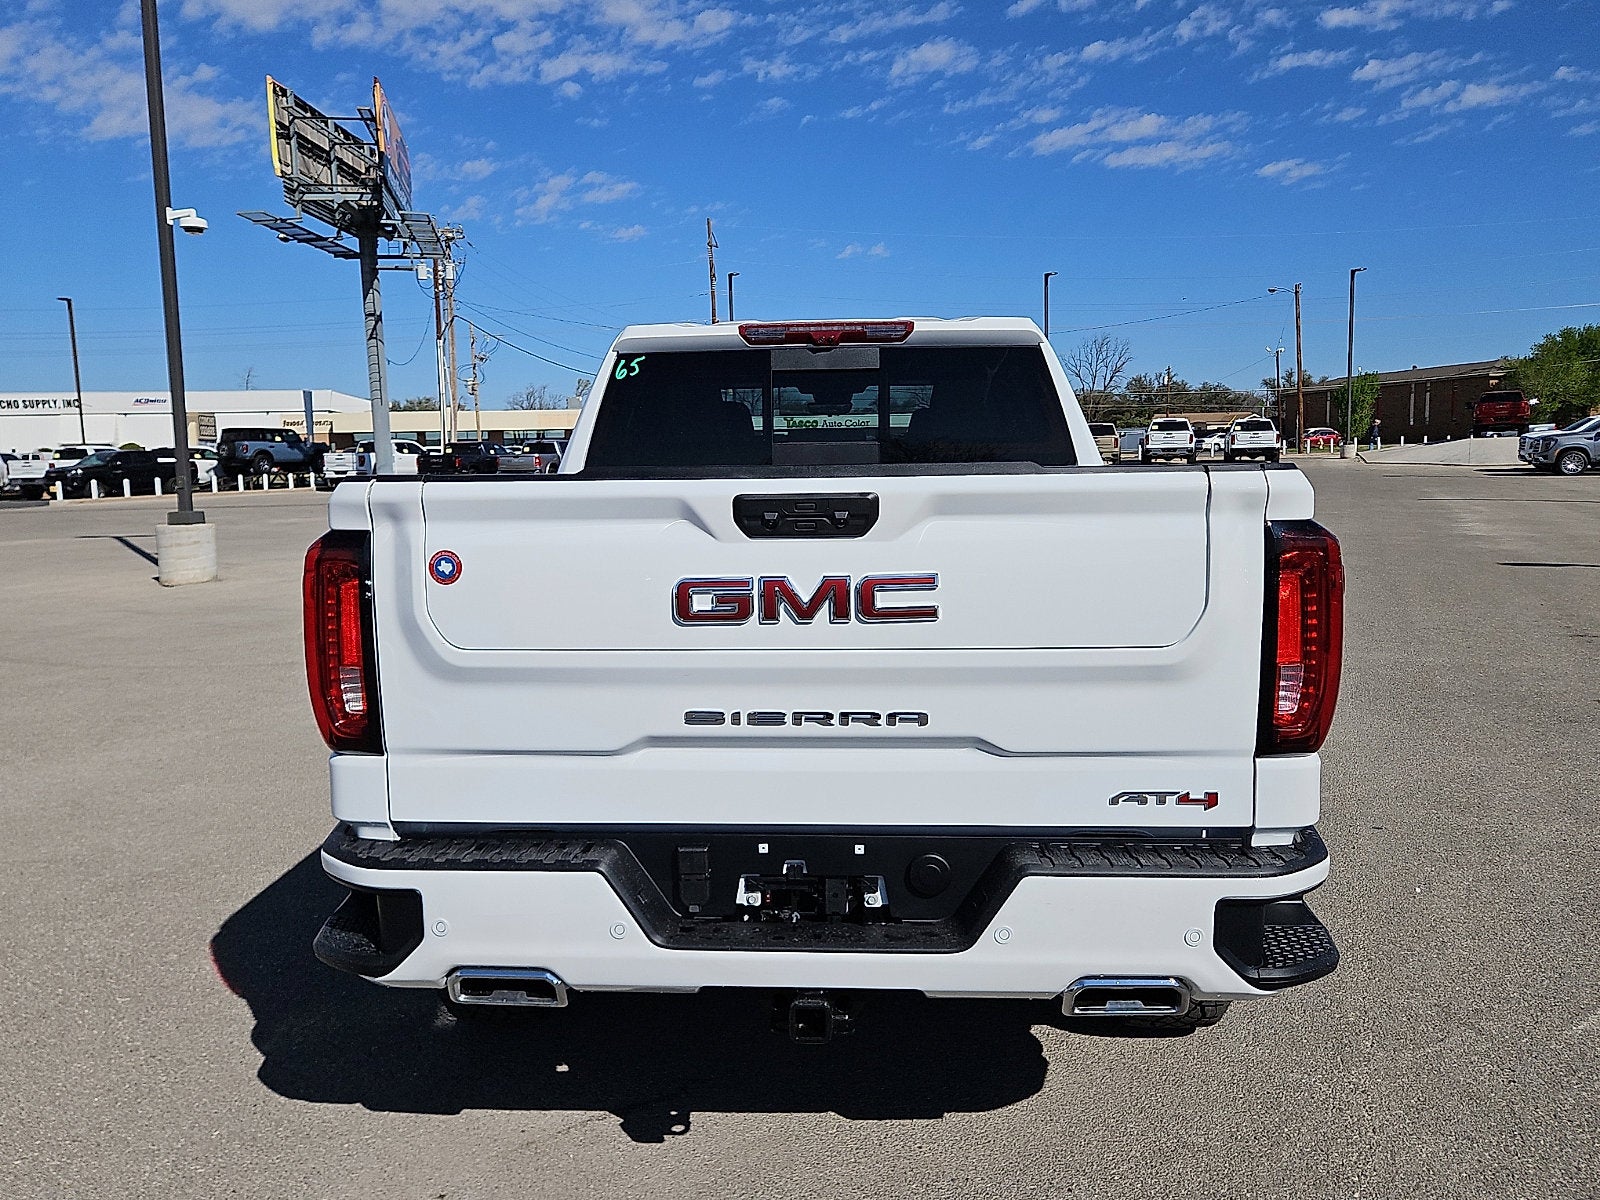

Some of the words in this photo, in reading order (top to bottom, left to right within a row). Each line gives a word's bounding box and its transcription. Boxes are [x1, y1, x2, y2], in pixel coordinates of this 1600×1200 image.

[615, 355, 646, 380] 65
[821, 419, 843, 429] Auto
[844, 418, 871, 428] Color
[671, 572, 939, 626] GMC
[683, 710, 929, 727] SIERRA
[1108, 791, 1219, 812] AT4
